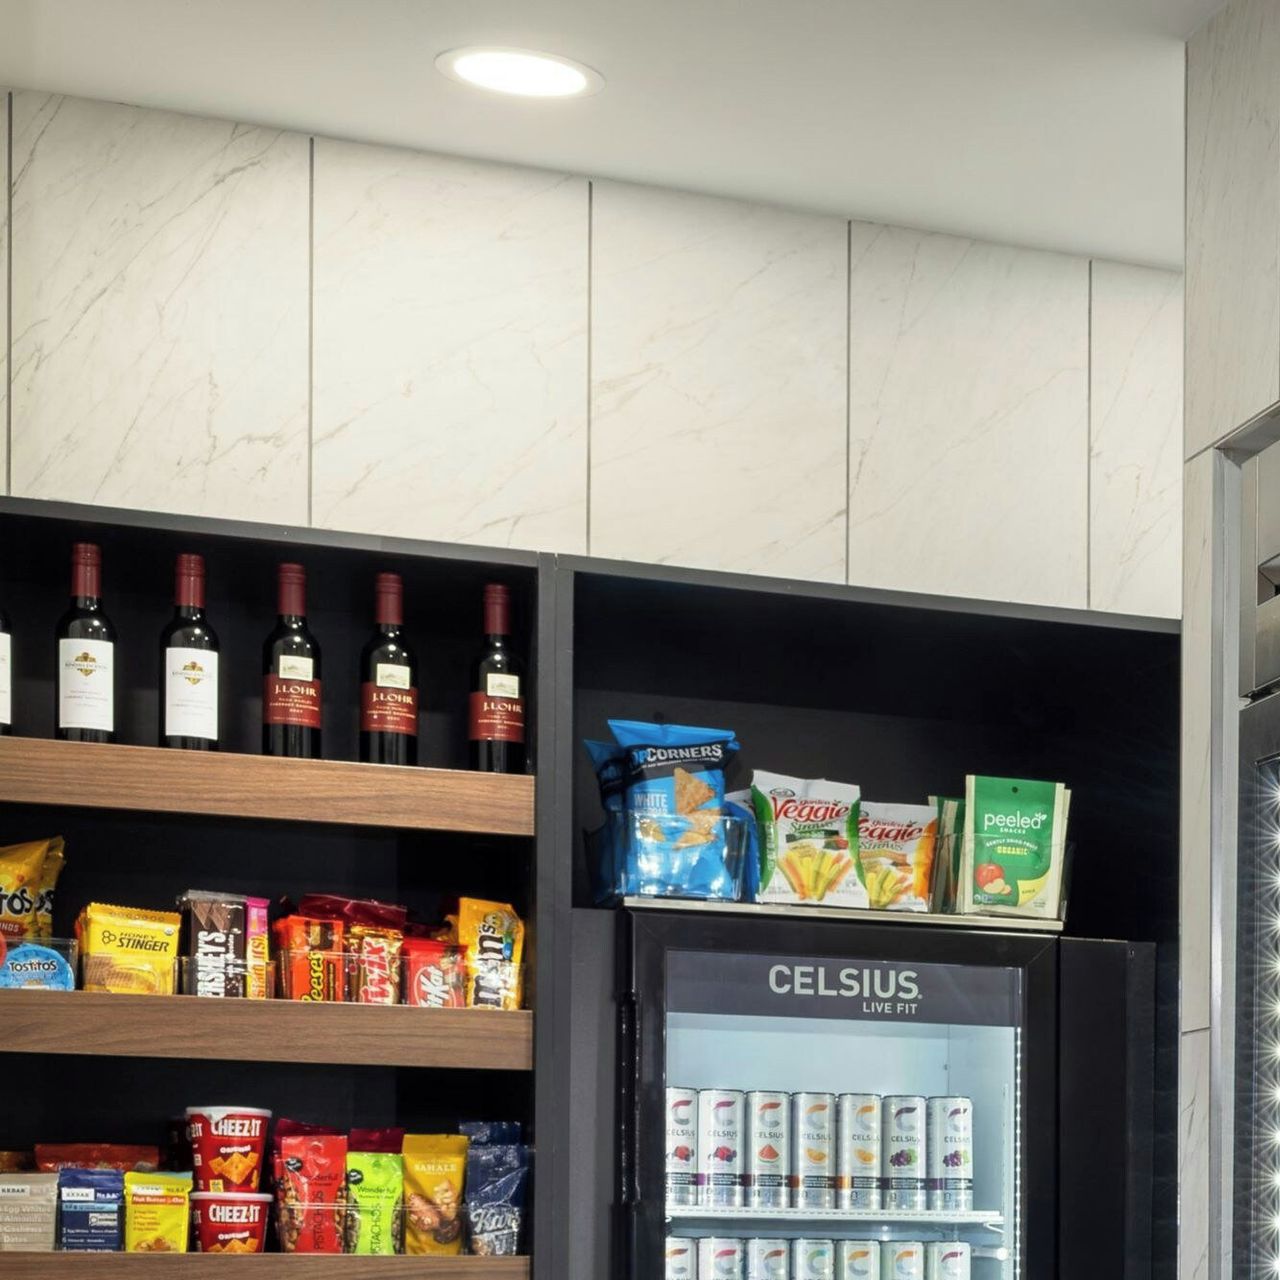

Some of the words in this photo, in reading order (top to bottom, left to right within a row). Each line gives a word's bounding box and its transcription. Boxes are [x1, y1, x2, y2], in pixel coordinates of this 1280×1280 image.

[771, 796, 850, 823] Veggie
[984, 810, 1042, 831] peeled
[117, 938, 170, 953] STINGER
[768, 964, 920, 1000] CELSIUS
[862, 1001, 893, 1013] LIVE
[896, 1003, 918, 1015] FIT
